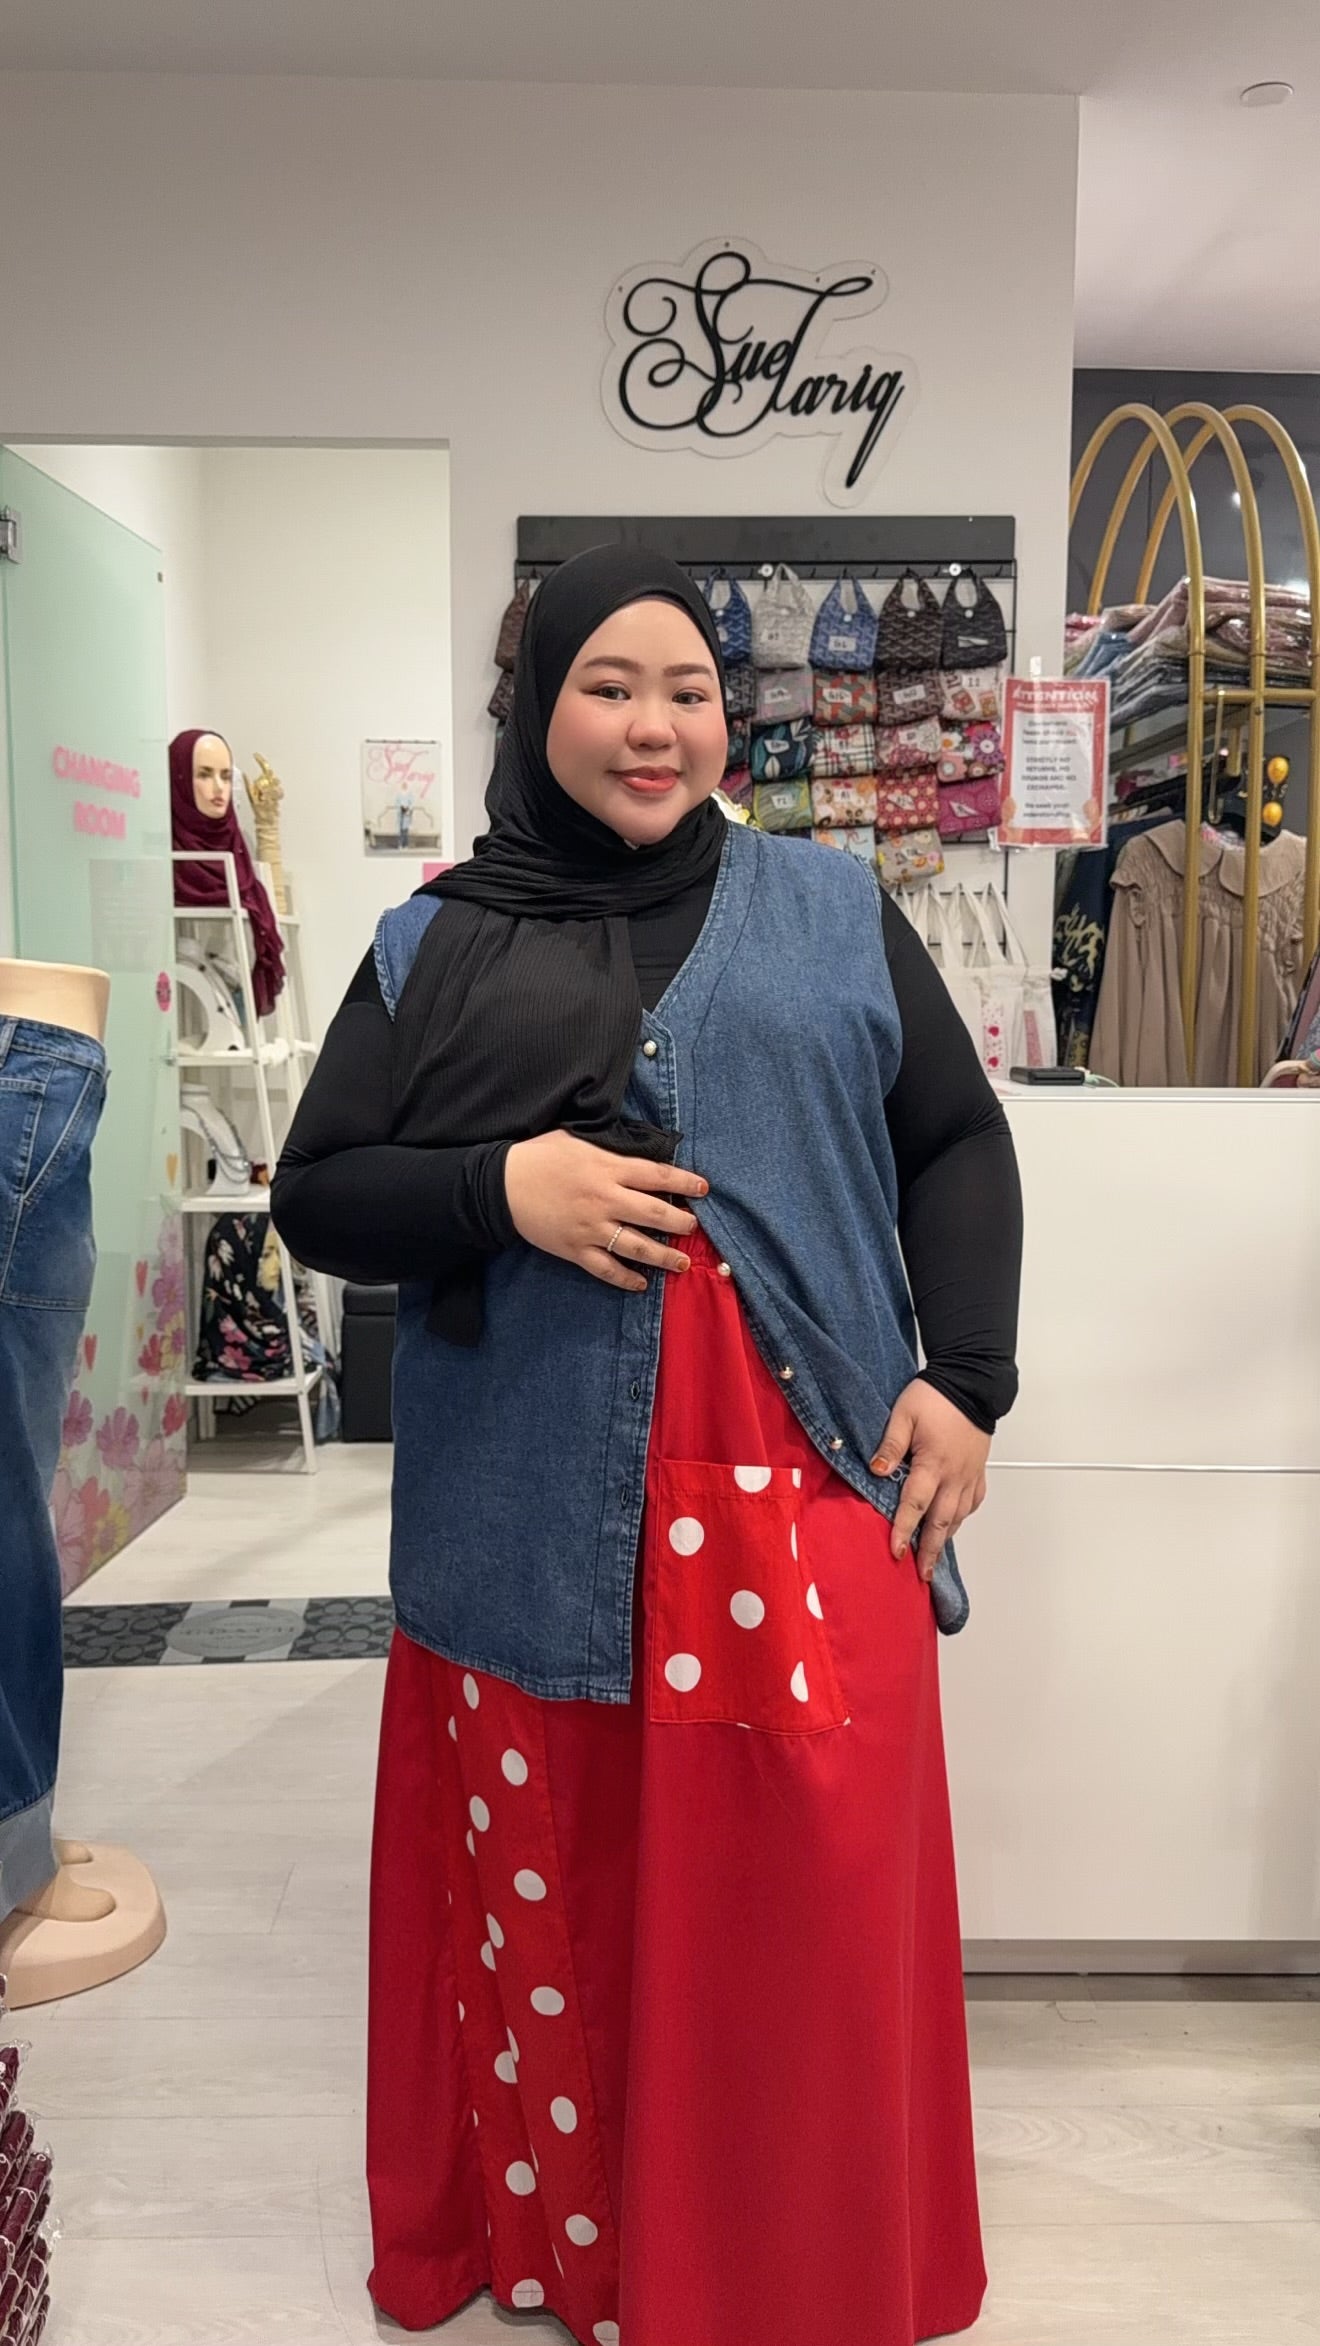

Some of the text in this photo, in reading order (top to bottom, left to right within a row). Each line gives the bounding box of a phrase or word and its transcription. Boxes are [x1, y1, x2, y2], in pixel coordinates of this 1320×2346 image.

[619, 251, 795, 431] Sue
[53, 745, 142, 799] CHANGING
[74, 800, 127, 840] ROOM
